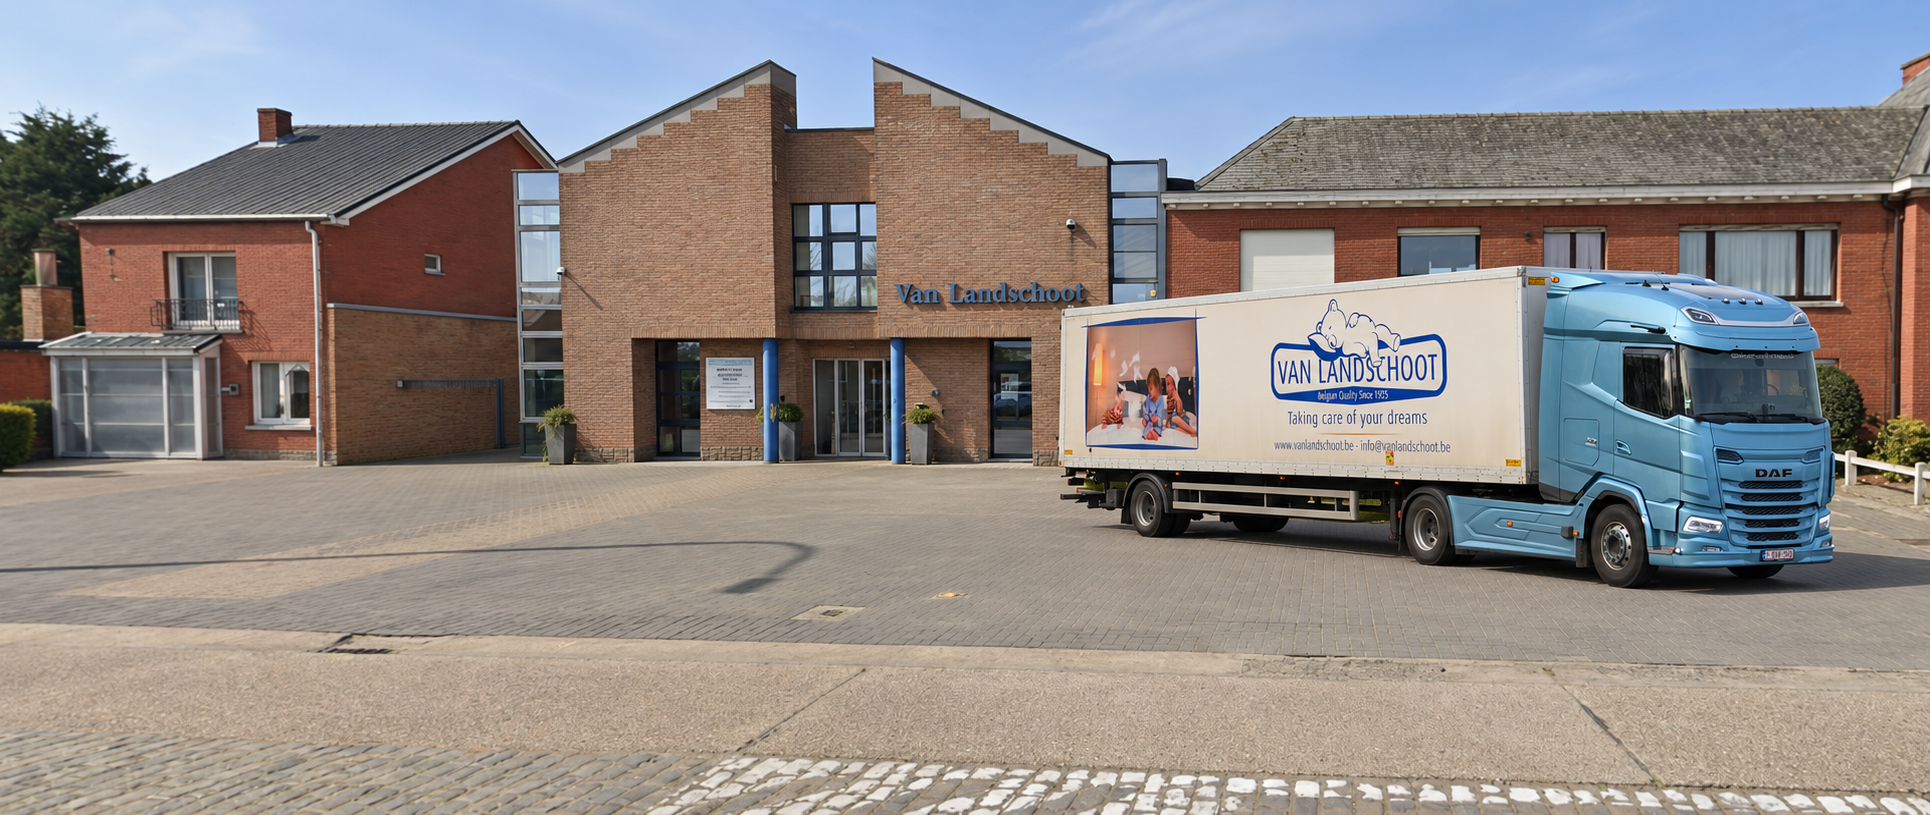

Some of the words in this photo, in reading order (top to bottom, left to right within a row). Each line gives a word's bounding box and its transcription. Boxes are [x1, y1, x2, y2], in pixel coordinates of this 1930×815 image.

[894, 283, 939, 304] Van
[948, 281, 1085, 304] Landschoot
[1277, 359, 1311, 385] VAN
[1318, 353, 1438, 384] LANDSCHOOT
[1338, 389, 1358, 402] Quality
[1287, 411, 1318, 428] Taking
[1322, 413, 1343, 425] care
[1346, 409, 1357, 425] of
[1360, 413, 1383, 429] your
[1387, 409, 1428, 425] dreams
[1274, 439, 1354, 451] www.vanlandschoot.be
[1360, 439, 1451, 453] info@vanlandschoot.be
[1755, 468, 1793, 478] DAF
